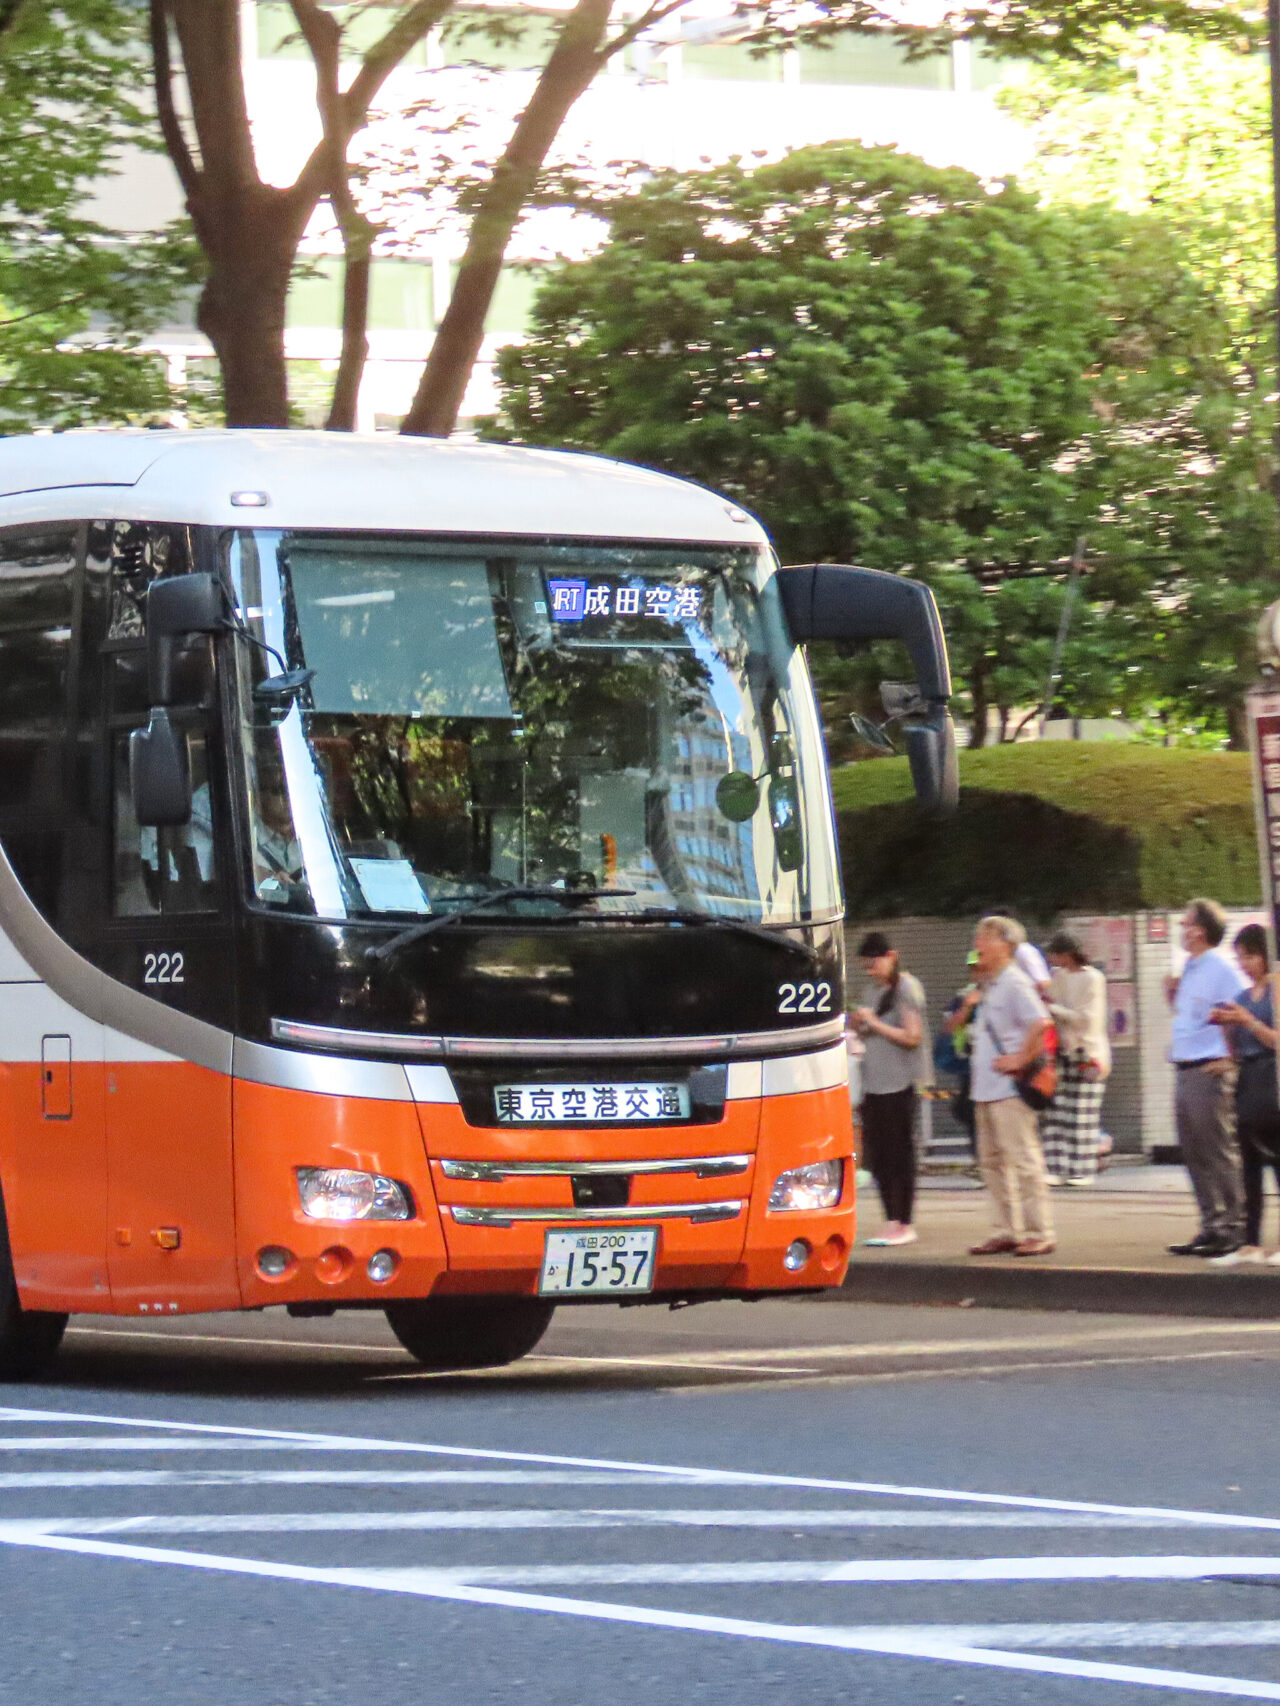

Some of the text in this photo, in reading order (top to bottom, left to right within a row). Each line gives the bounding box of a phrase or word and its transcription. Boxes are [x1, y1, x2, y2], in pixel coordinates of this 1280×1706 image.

[584, 586, 700, 617] 成田空港
[144, 952, 184, 983] 222
[778, 982, 832, 1013] 222
[497, 1087, 682, 1120] 東京空港交通
[576, 1235, 626, 1249] 成田 200
[565, 1250, 649, 1287] 15-57
